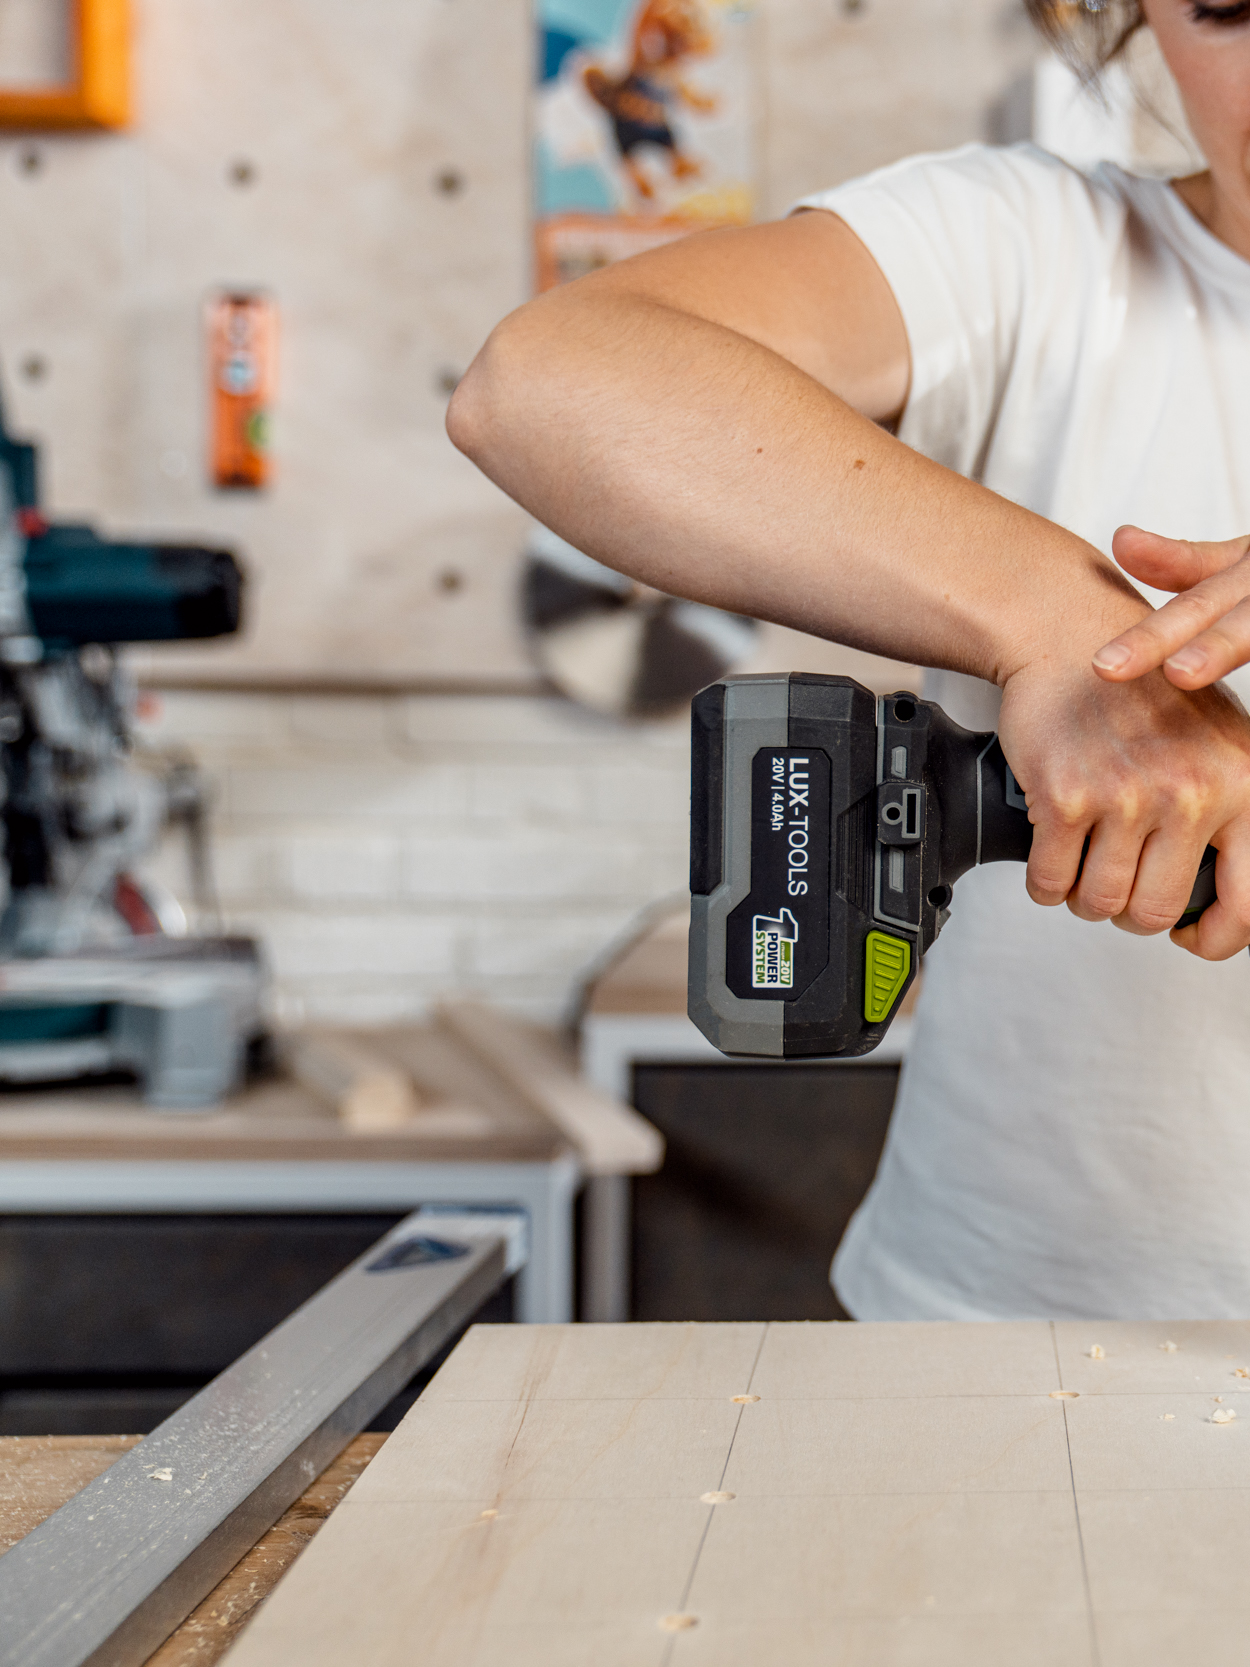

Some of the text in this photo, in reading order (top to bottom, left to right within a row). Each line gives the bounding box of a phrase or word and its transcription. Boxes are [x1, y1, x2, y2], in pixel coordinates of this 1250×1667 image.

[772, 757, 785, 783] 20V
[772, 792, 785, 831] 4.0Ah
[788, 758, 809, 896] LUX-TOOLS
[756, 932, 766, 984] SYSTEM
[767, 932, 779, 983] POWER
[780, 960, 791, 983] 20V
